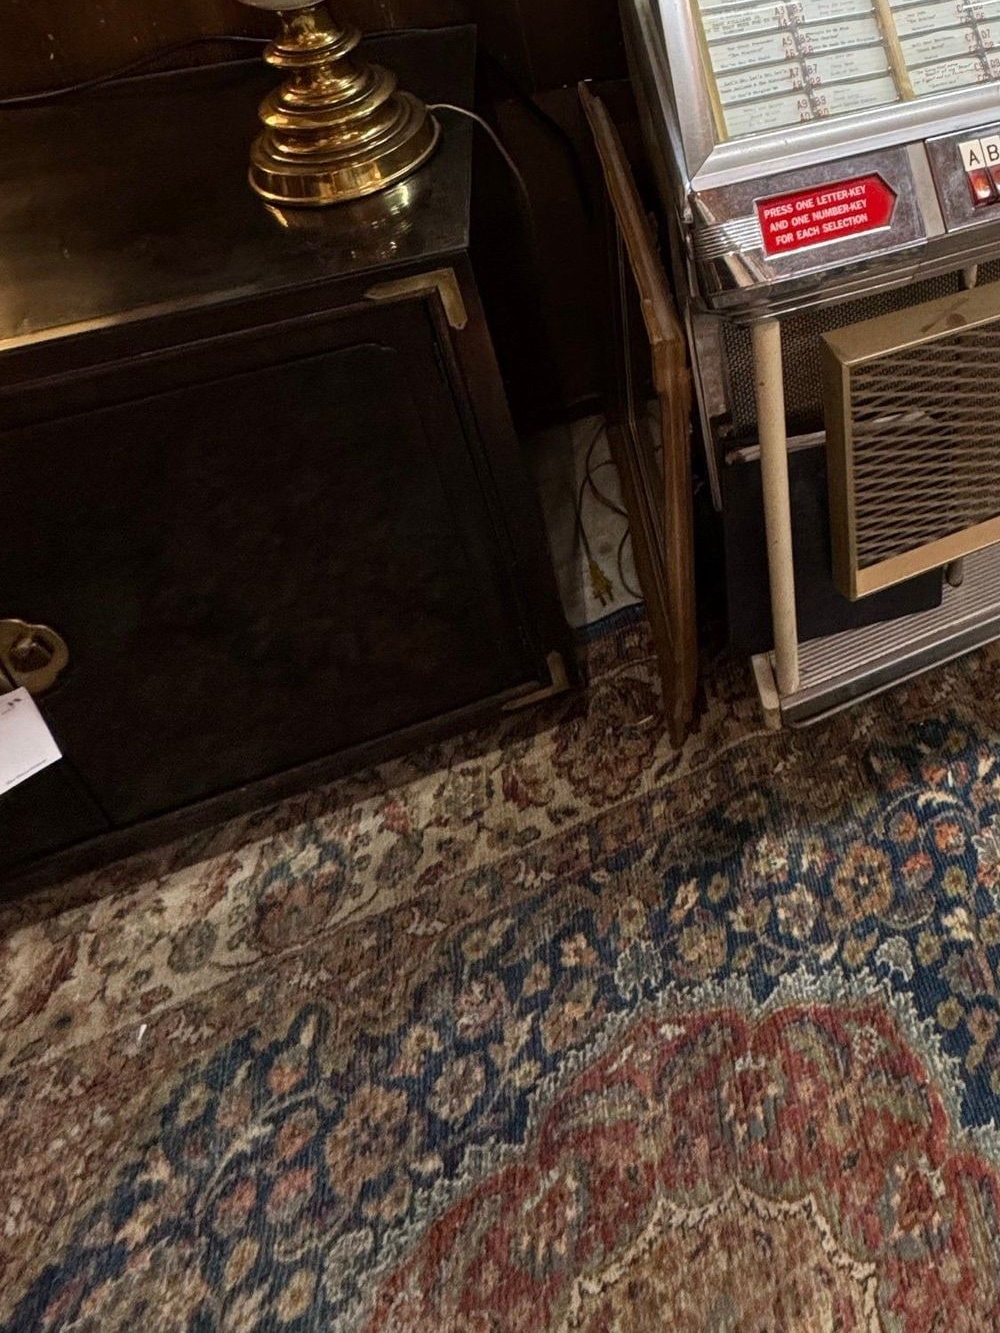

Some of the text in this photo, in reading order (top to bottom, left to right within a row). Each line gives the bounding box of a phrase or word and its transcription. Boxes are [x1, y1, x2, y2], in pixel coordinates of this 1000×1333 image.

[782, 35, 793, 46] A5
[763, 185, 867, 219] PRESS ONE LETTER-KEY
[769, 199, 868, 233] AND ONE NUMBER-KEY
[775, 213, 869, 246] FOR EACH SELECTION
